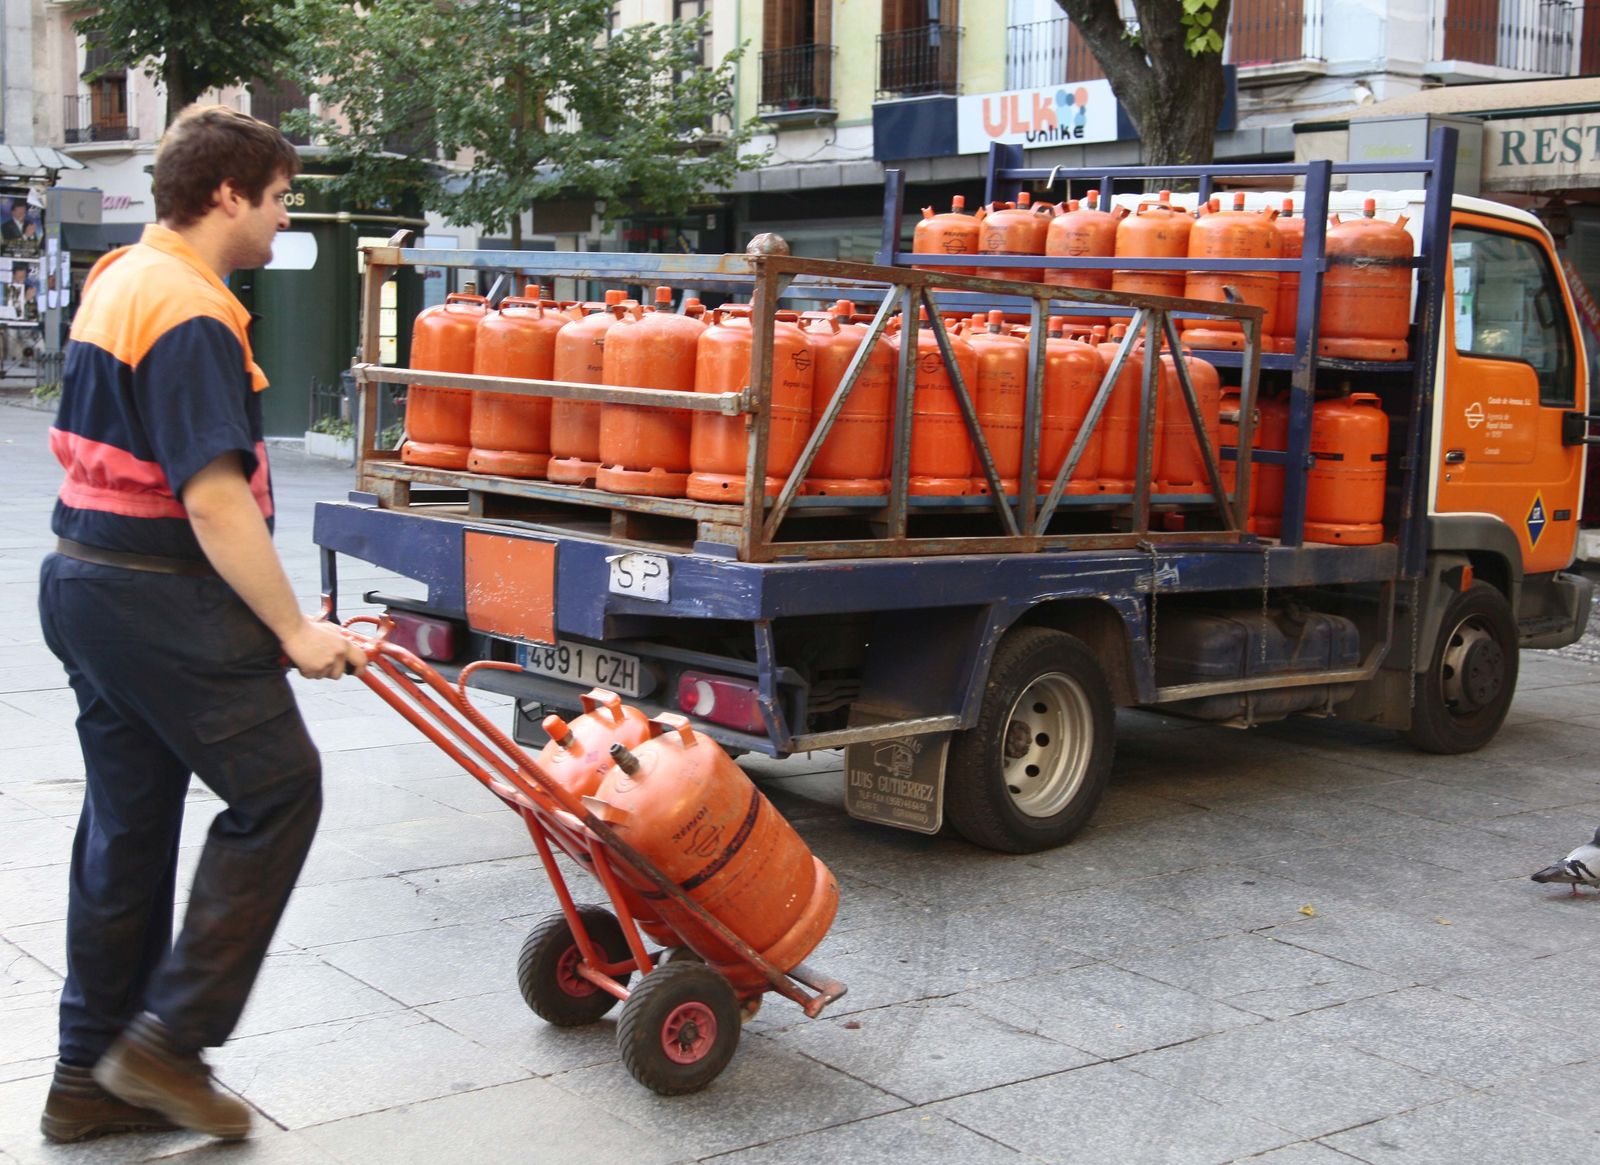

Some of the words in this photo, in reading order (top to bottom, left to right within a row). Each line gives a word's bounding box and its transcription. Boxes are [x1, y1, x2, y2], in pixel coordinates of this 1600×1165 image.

[279, 193, 305, 206] OS
[530, 645, 583, 679] 4891
[596, 655, 635, 691] CZH
